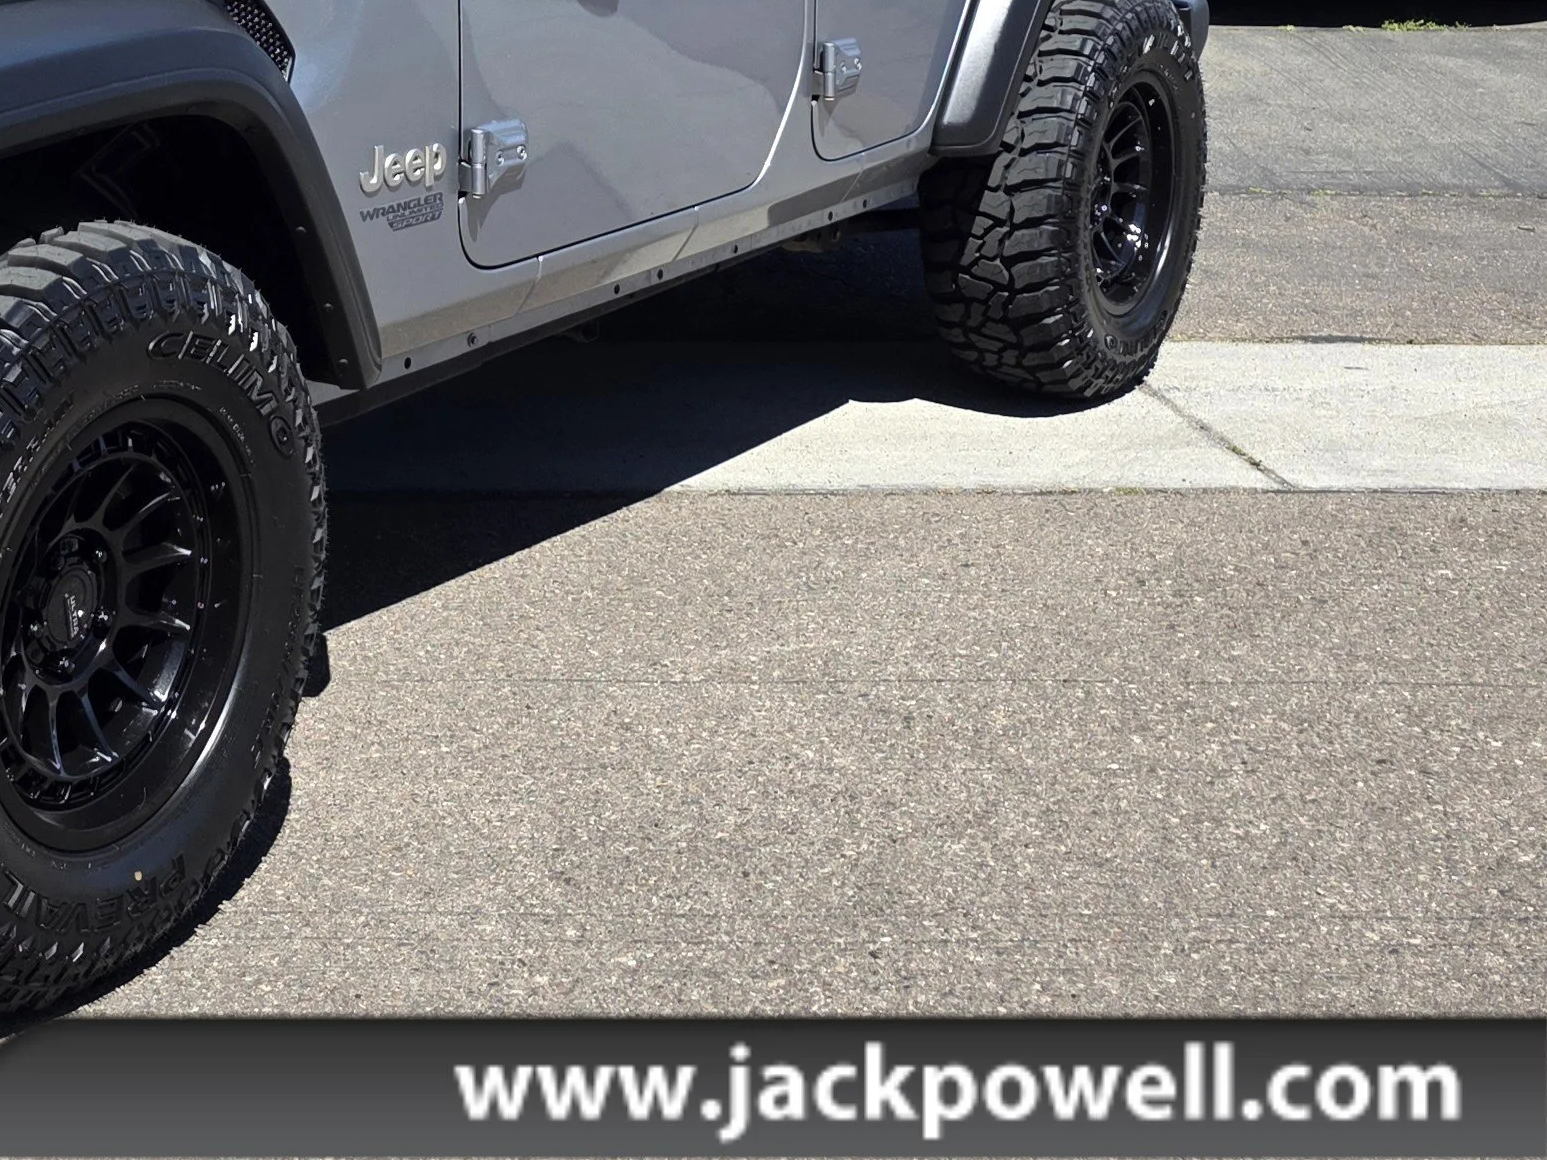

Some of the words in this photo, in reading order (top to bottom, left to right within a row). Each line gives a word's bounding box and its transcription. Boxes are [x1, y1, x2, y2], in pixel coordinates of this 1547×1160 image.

[359, 142, 447, 193] Jeep
[359, 192, 444, 223] WRANGLER
[386, 201, 444, 222] UNLIMITED
[391, 211, 443, 231] SPORT
